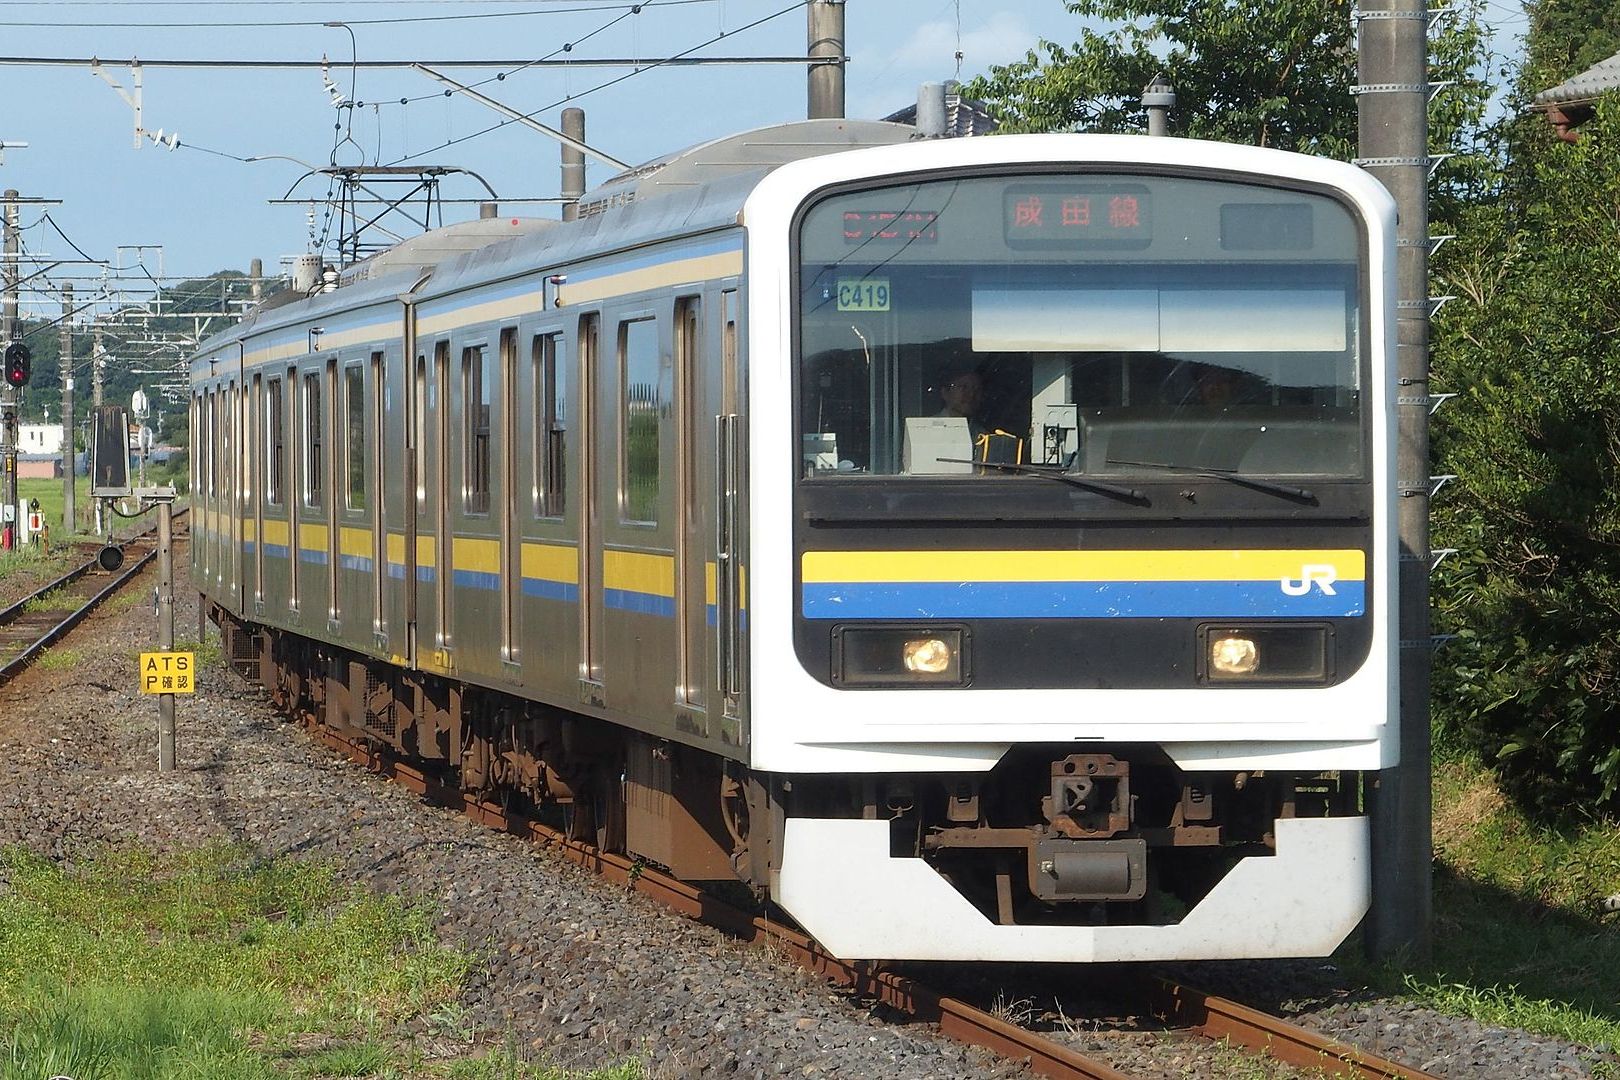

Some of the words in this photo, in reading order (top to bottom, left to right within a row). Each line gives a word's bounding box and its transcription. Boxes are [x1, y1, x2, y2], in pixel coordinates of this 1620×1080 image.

[1015, 195, 1139, 227] 成田線
[840, 285, 888, 307] C419
[1281, 564, 1337, 596] JR
[146, 656, 188, 671] ATS
[146, 675, 188, 689] P確認
